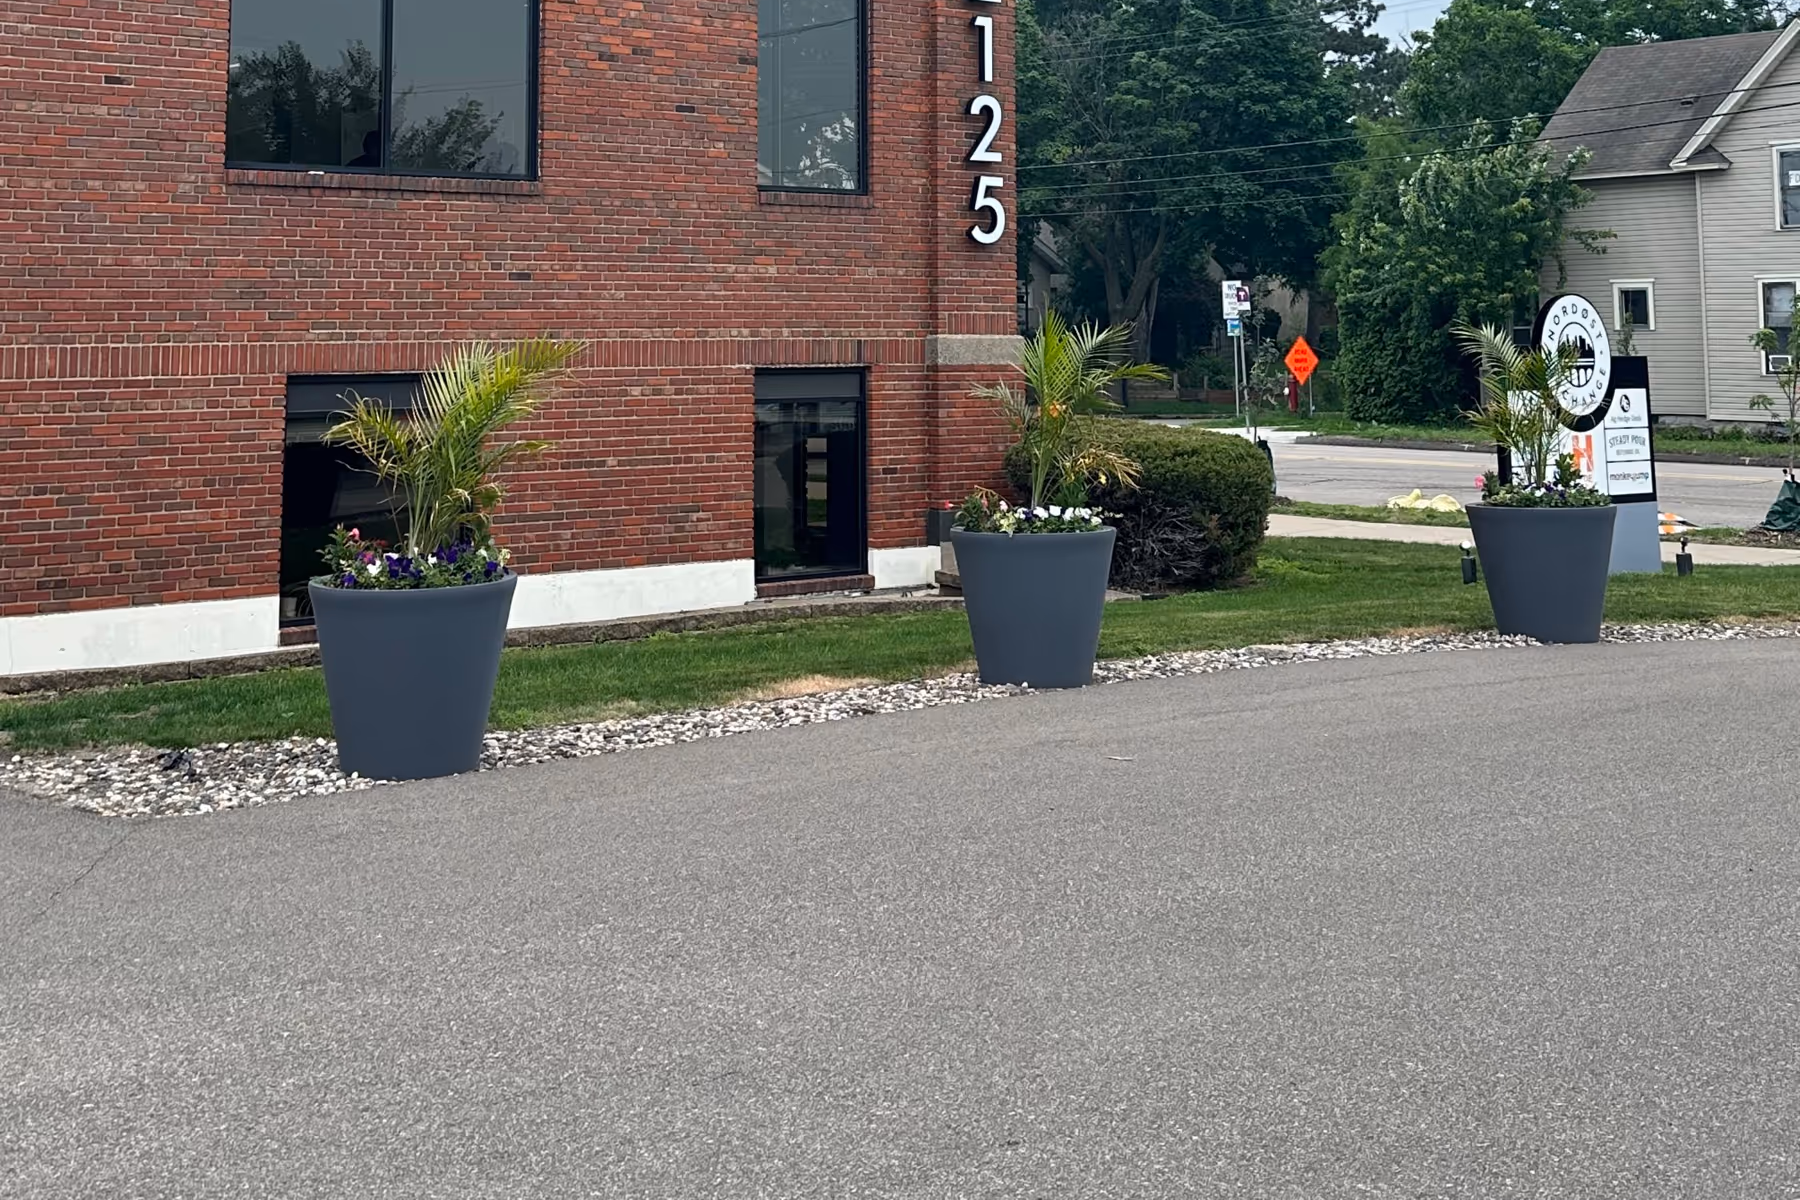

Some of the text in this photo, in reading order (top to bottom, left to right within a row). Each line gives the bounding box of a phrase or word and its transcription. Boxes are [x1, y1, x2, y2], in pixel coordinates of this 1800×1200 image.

[1547, 303, 1603, 341] NORDØST
[1560, 367, 1607, 406] CHANGE
[1609, 434, 1630, 448] STEADY
